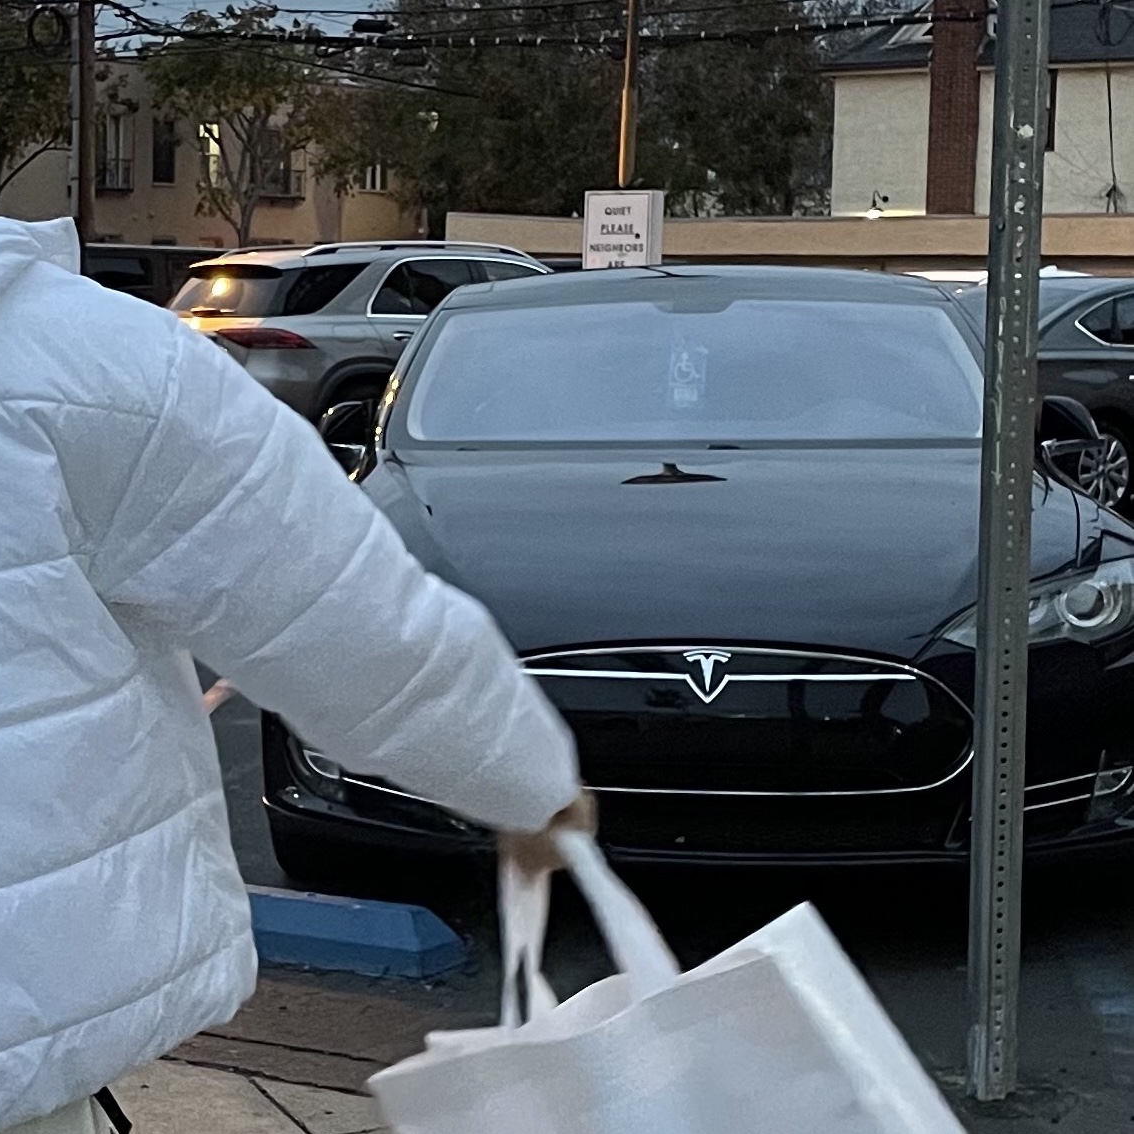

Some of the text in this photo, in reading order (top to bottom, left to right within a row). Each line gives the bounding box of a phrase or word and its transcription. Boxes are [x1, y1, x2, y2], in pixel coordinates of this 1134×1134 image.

[604, 205, 632, 216] QUIET
[600, 223, 634, 235] PLEASE
[589, 243, 644, 252] NEIGHBORS
